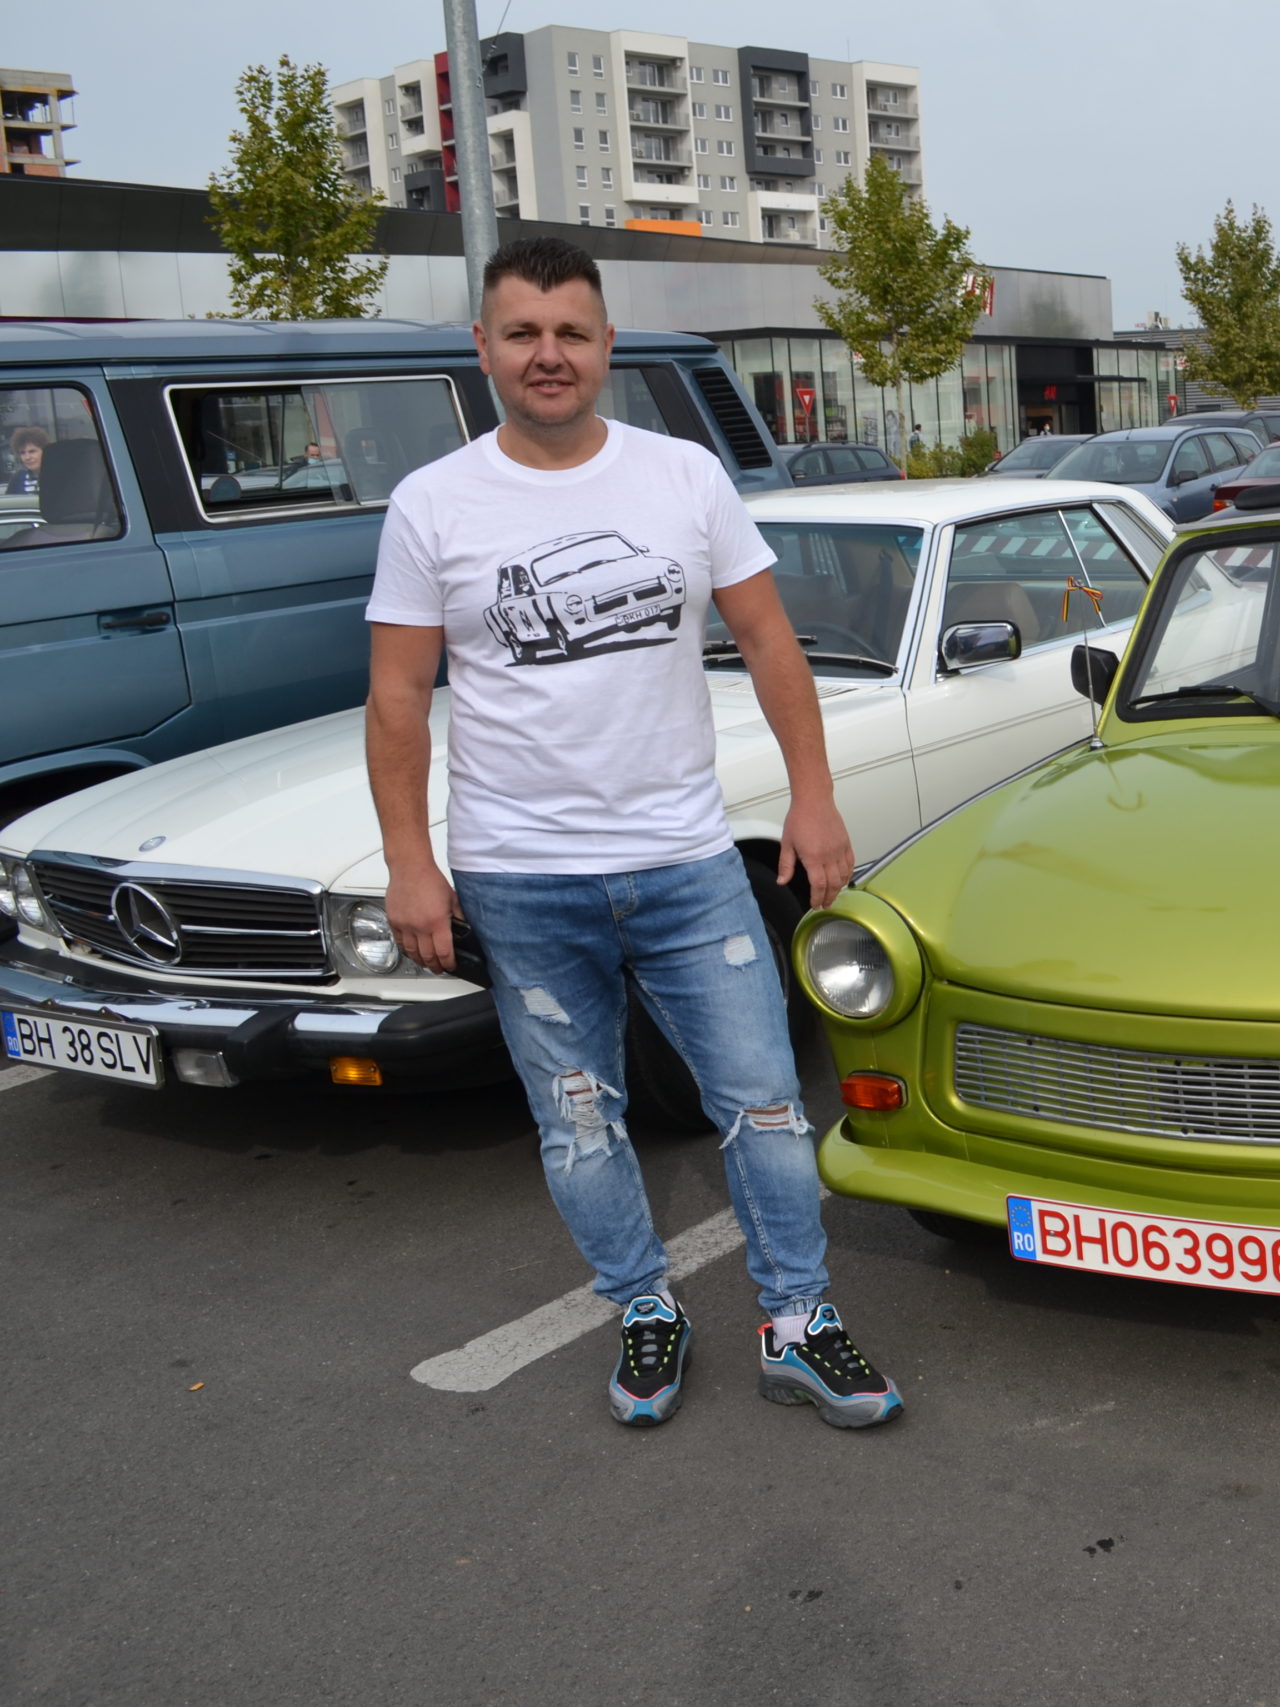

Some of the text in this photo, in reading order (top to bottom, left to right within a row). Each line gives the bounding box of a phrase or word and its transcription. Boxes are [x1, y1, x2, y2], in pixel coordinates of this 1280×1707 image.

[8, 1036, 18, 1052] RO
[17, 1018, 151, 1075] BH 38 SLV
[1014, 1232, 1034, 1252] RO
